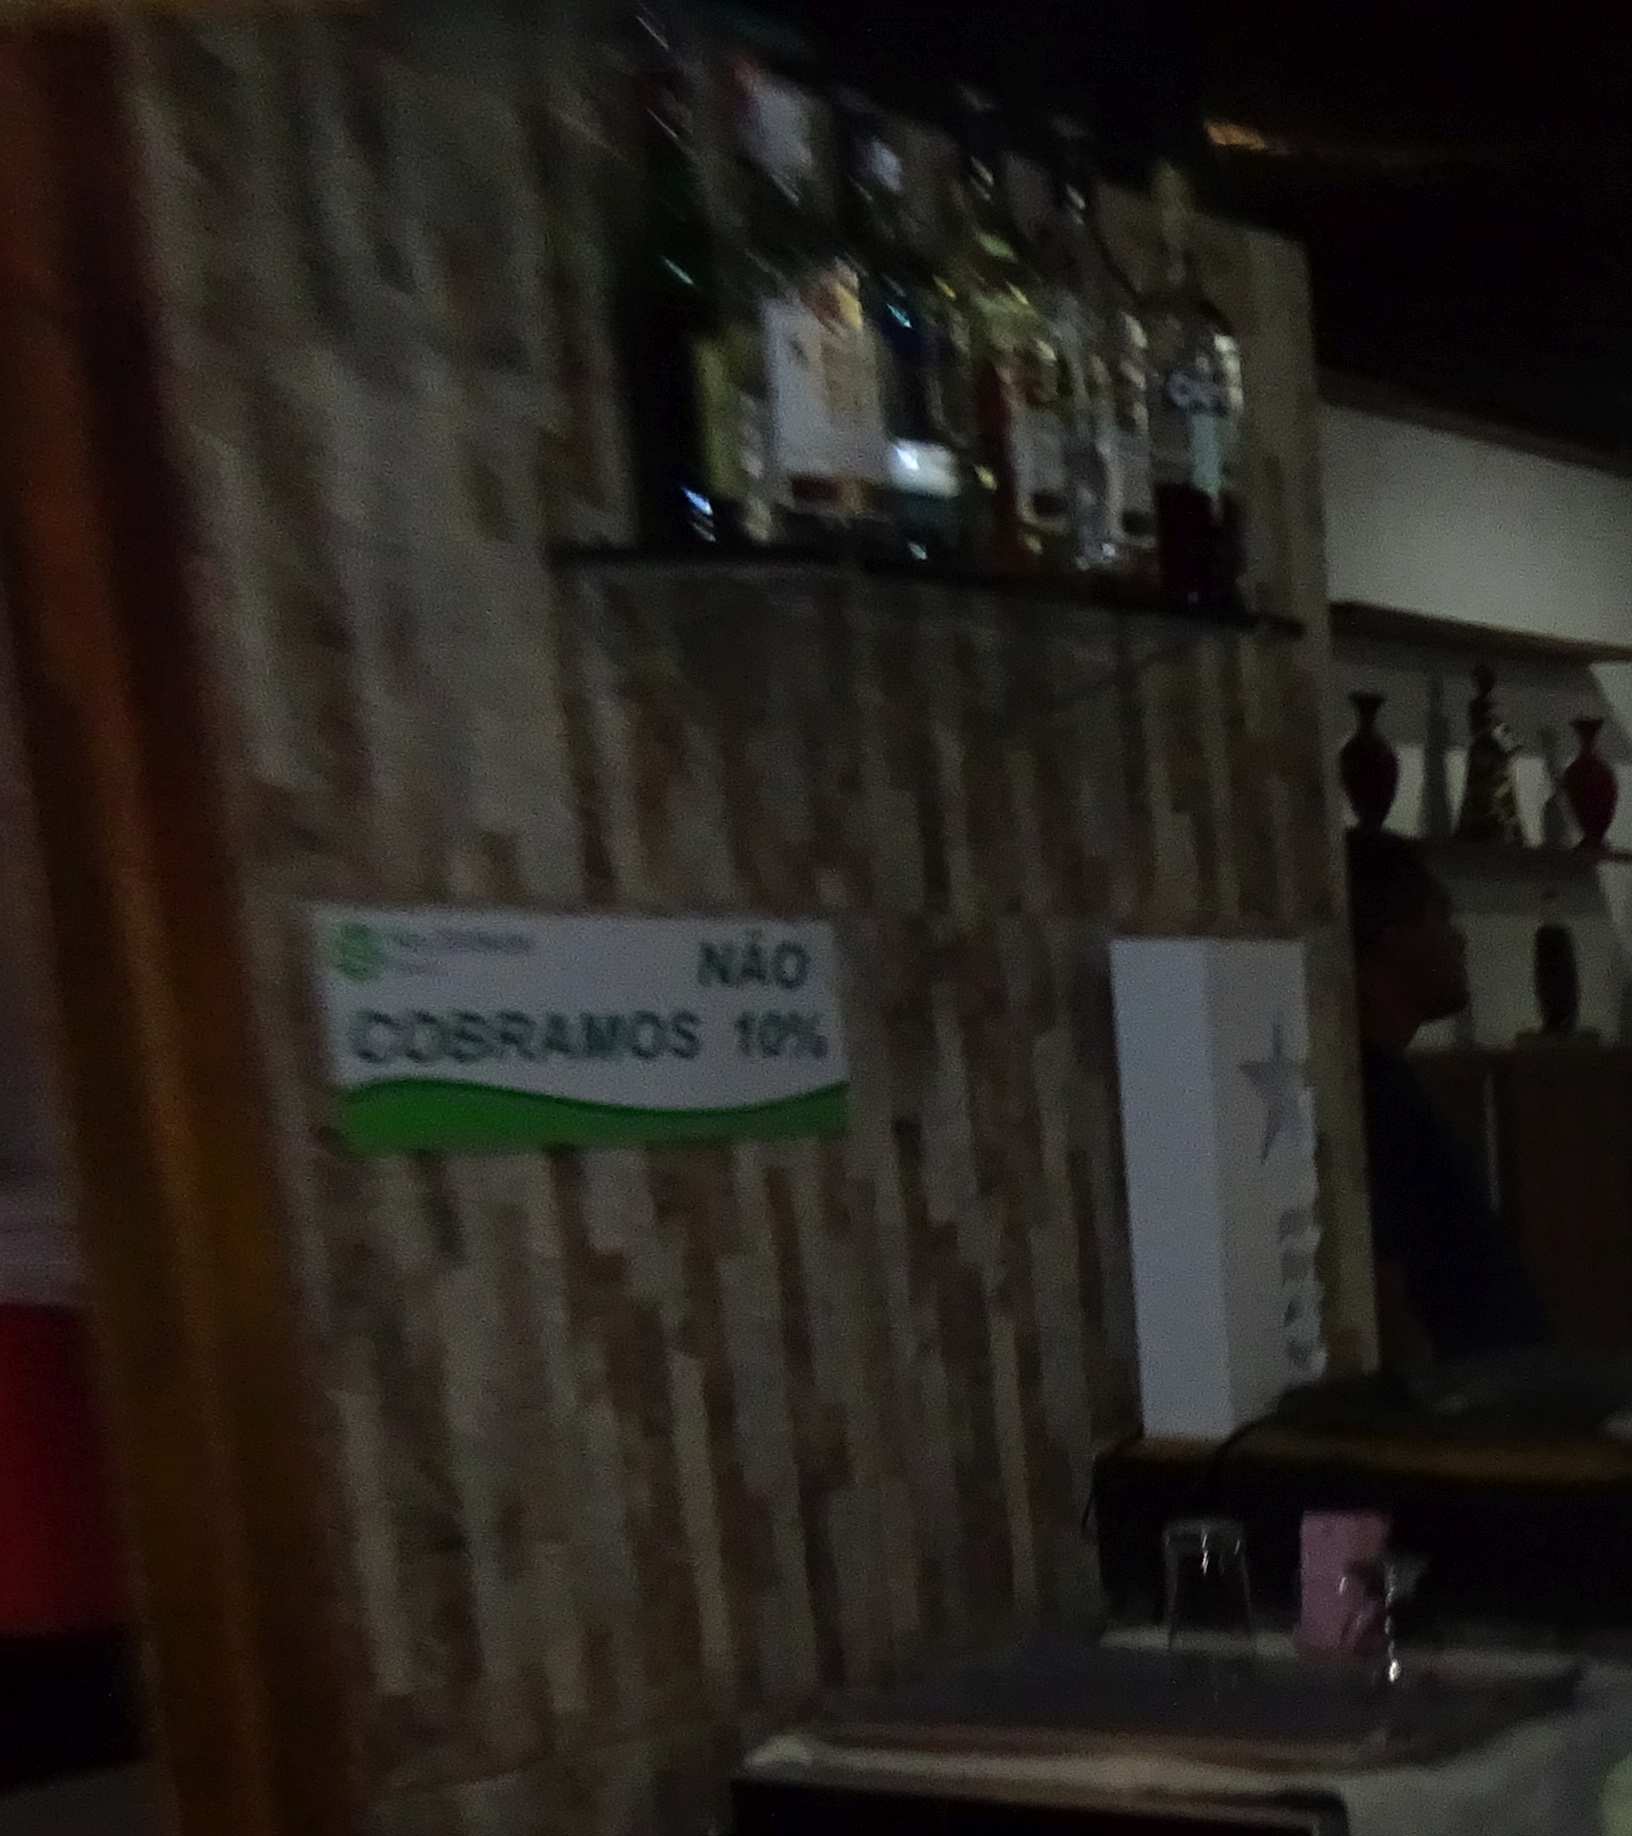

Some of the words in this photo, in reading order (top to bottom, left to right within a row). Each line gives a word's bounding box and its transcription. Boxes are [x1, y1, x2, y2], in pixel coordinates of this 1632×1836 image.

[698, 929, 808, 988] NÃO
[350, 1009, 701, 1063] COBRAMOS
[736, 1008, 829, 1060] 10%
